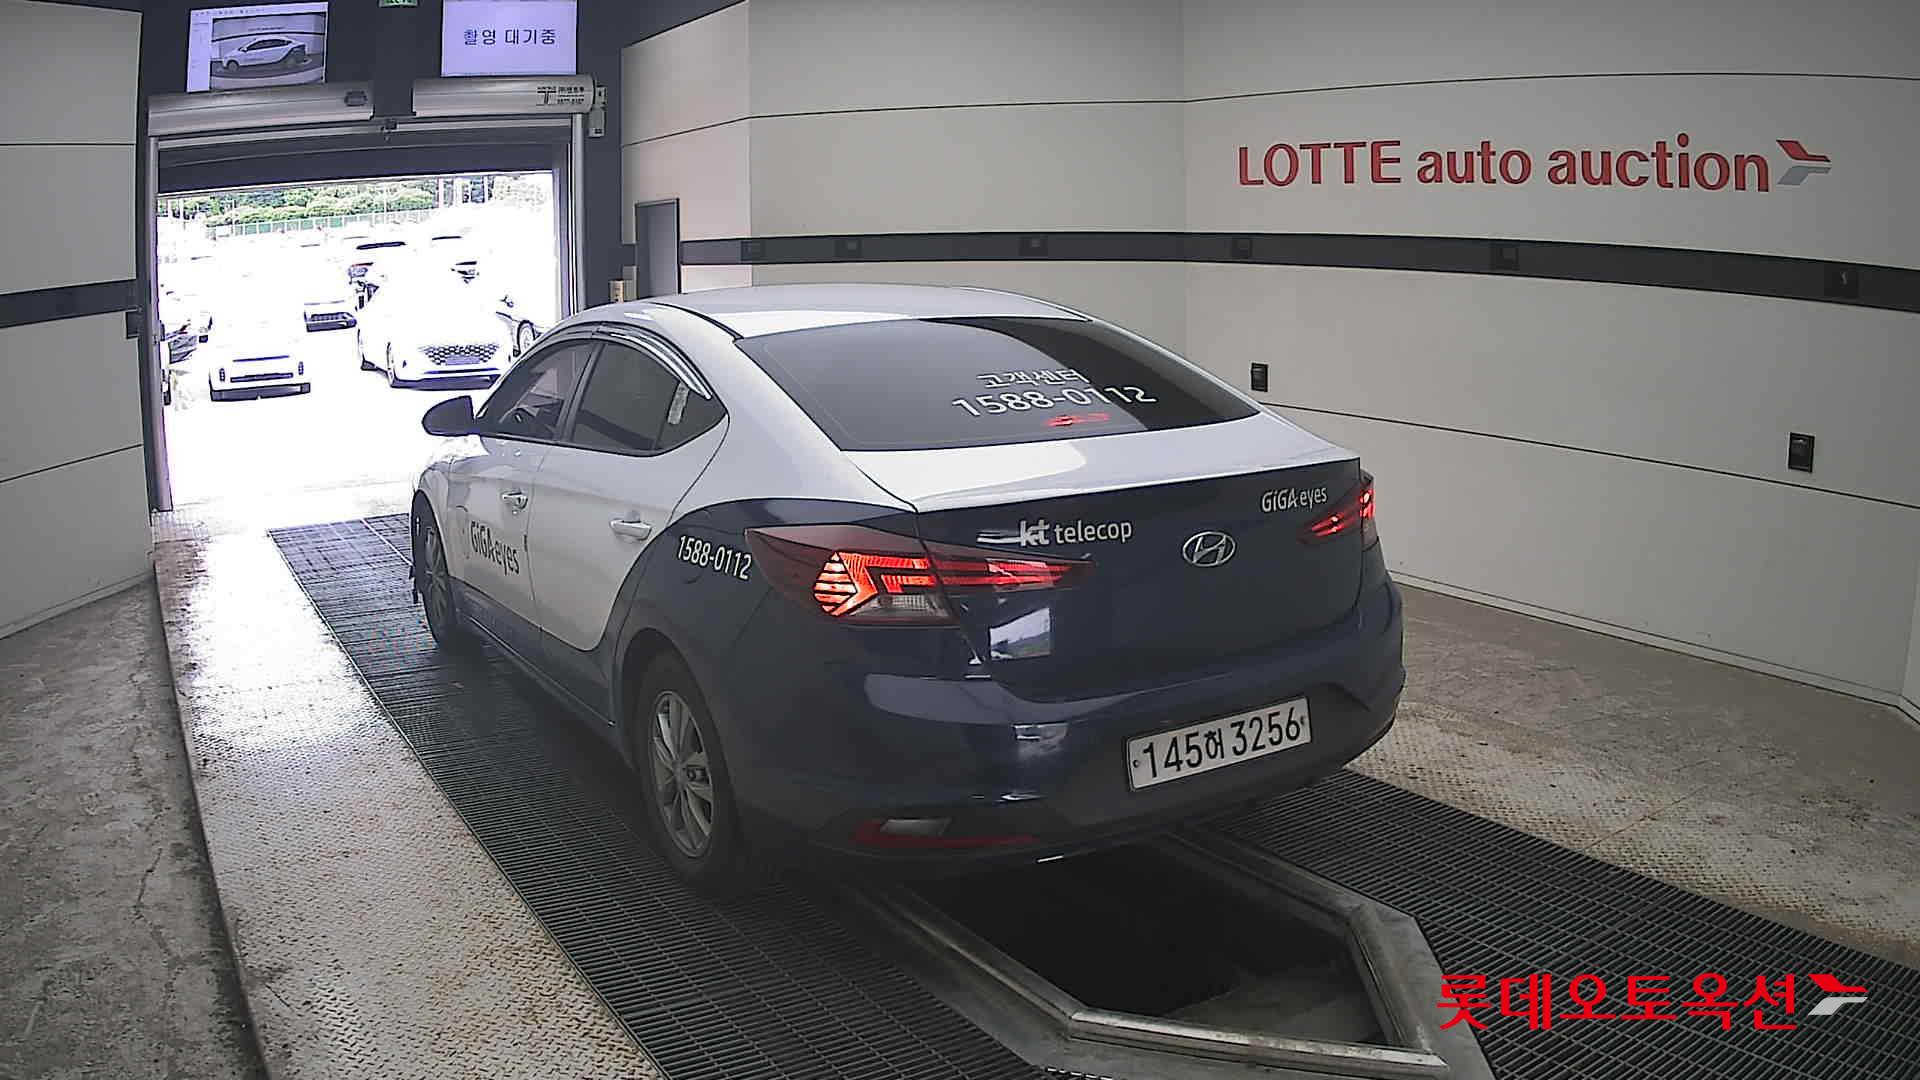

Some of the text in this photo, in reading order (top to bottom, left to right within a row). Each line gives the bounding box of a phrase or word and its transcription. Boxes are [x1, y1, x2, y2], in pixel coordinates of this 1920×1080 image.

[504, 29, 556, 45] 대기중
[1239, 133, 1770, 192] LOTTE auto auction
[977, 369, 1090, 388] 고객센터
[952, 386, 1157, 417] 1588-0112
[1020, 519, 1132, 546] kt telecop
[677, 535, 752, 580] 1588-0112
[1143, 706, 1301, 778] 145허 3256
